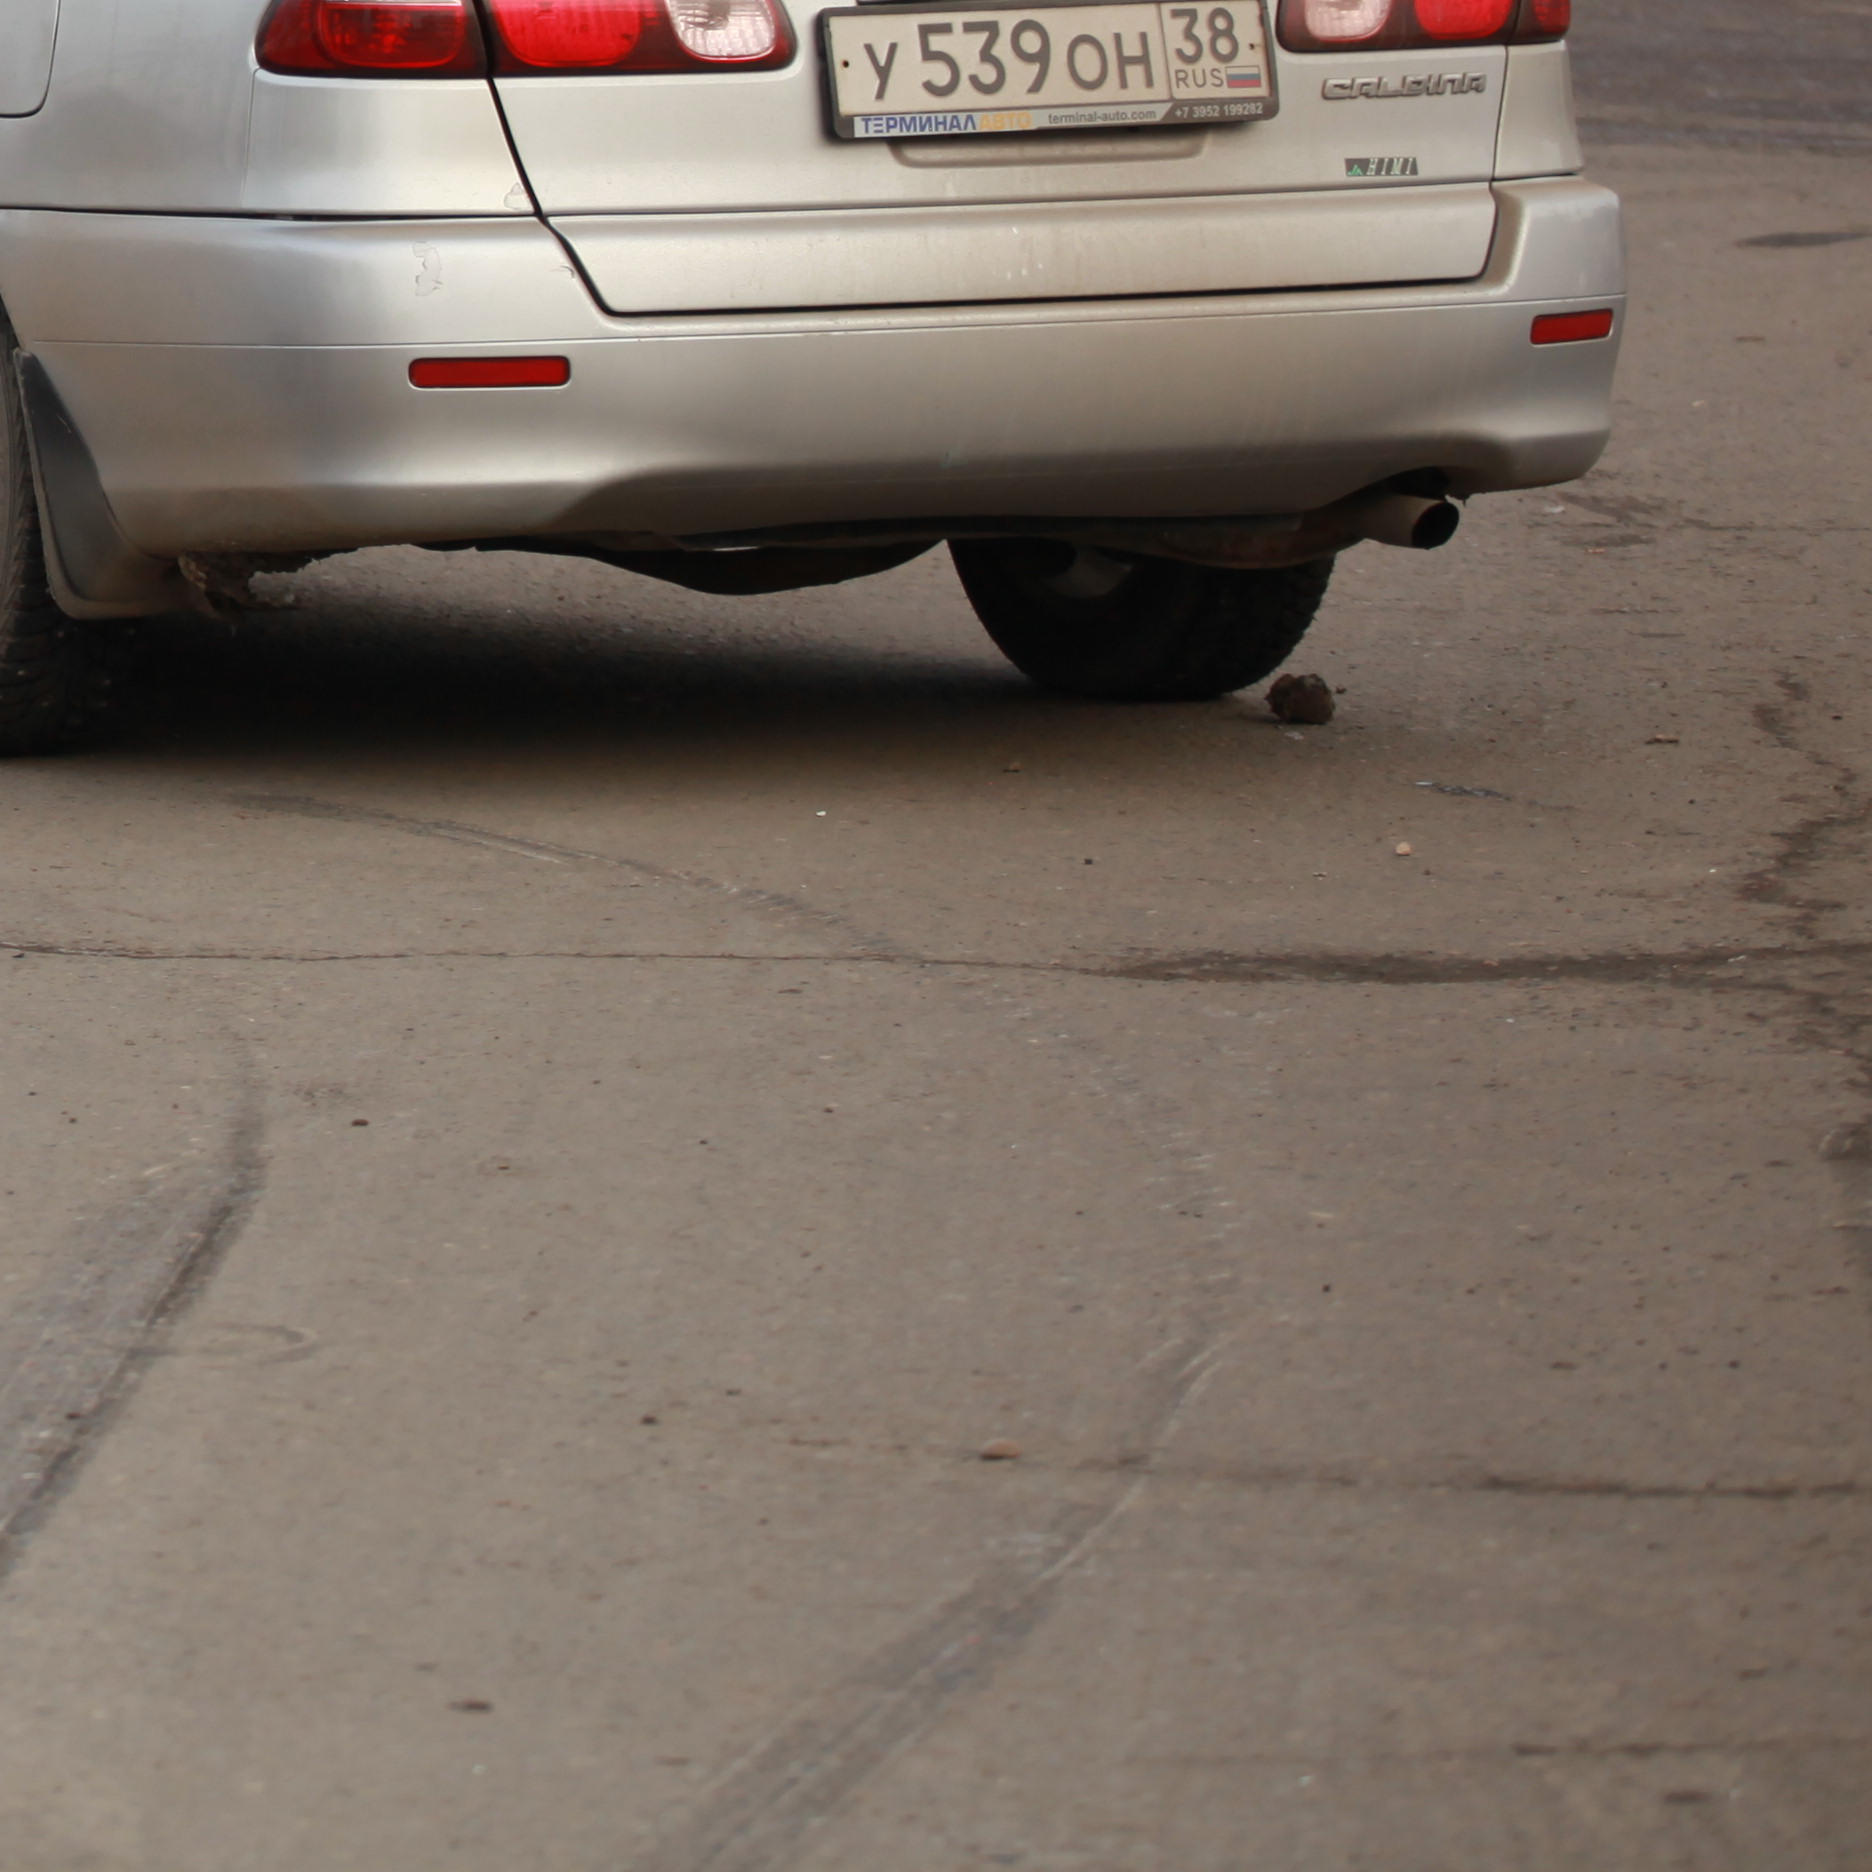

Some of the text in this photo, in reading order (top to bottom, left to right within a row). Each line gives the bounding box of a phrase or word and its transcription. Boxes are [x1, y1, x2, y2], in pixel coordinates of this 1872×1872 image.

[1170, 7, 1239, 64] 38
[1175, 68, 1223, 88] RUS
[1322, 73, 1487, 100] CALDINA
[1047, 109, 1156, 125] terminal-auto.com
[1175, 102, 1264, 119] +7 3952 199282
